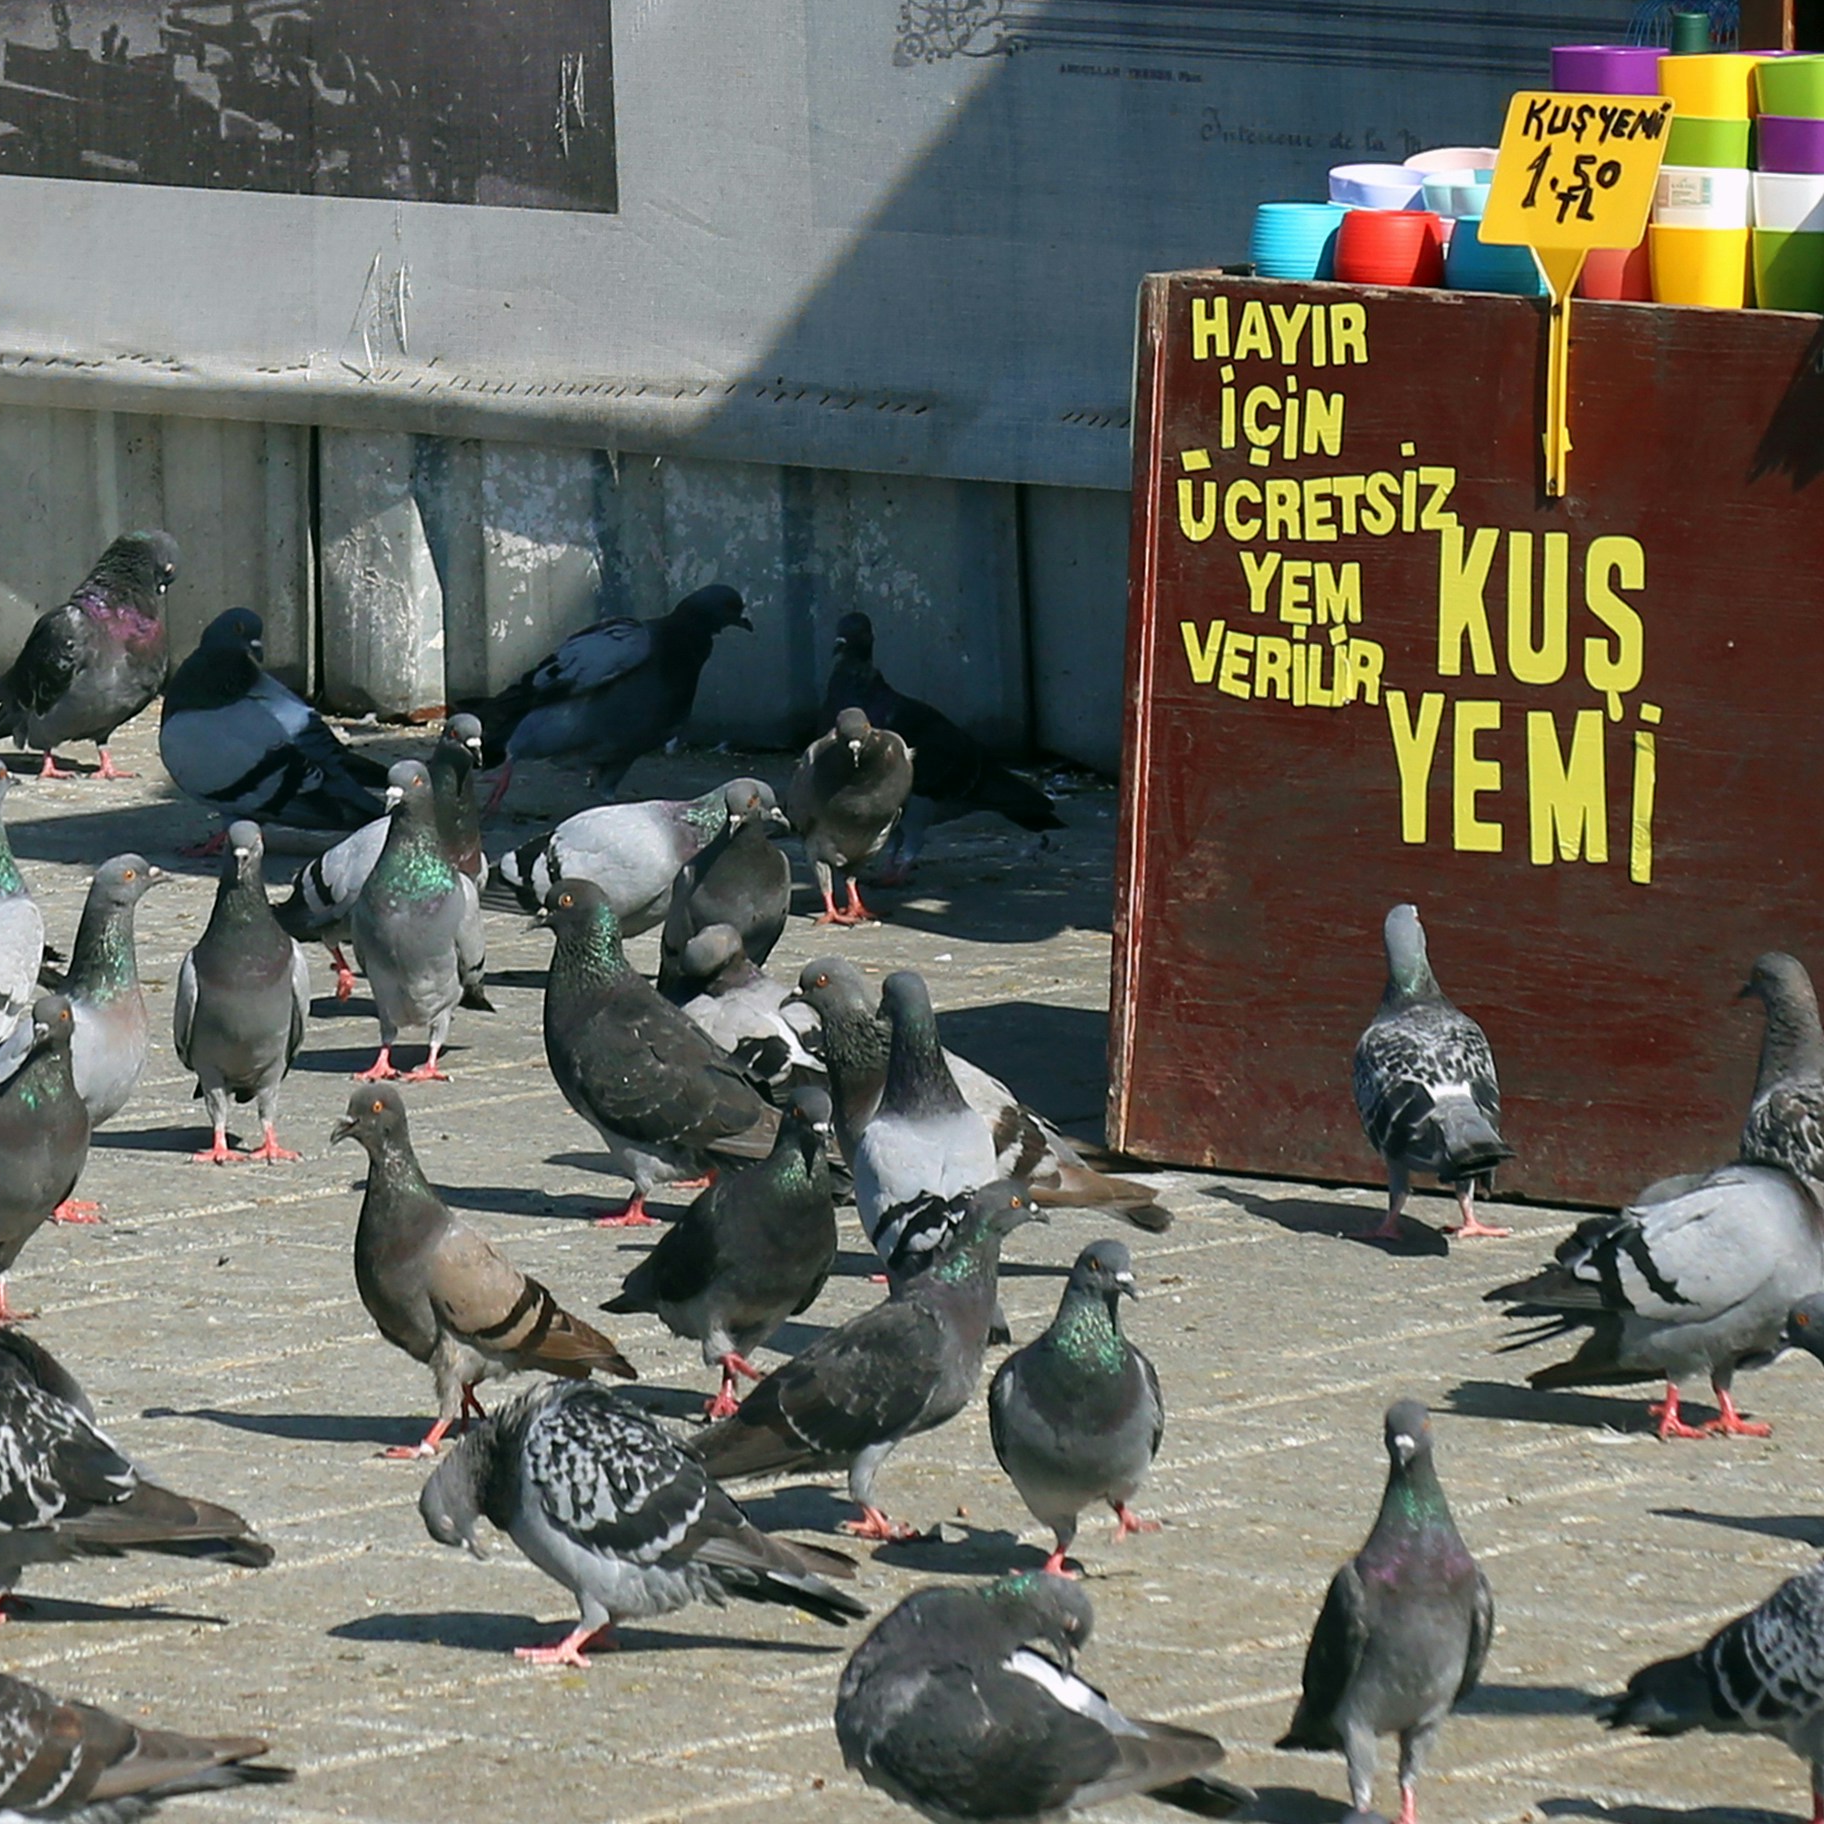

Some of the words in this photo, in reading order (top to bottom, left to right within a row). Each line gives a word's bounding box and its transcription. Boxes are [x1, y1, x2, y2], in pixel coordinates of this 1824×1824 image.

[1556, 187, 1595, 225] TL
[1191, 296, 1369, 368] HAYIR
[1219, 364, 1345, 467] İÇİN
[1177, 441, 1458, 542] ÜCRETSİZ
[1239, 550, 1362, 626] YEM
[1437, 525, 1646, 723] KUŞ
[1179, 619, 1385, 708] VERİLİR
[1385, 689, 1663, 885] YEMİ
